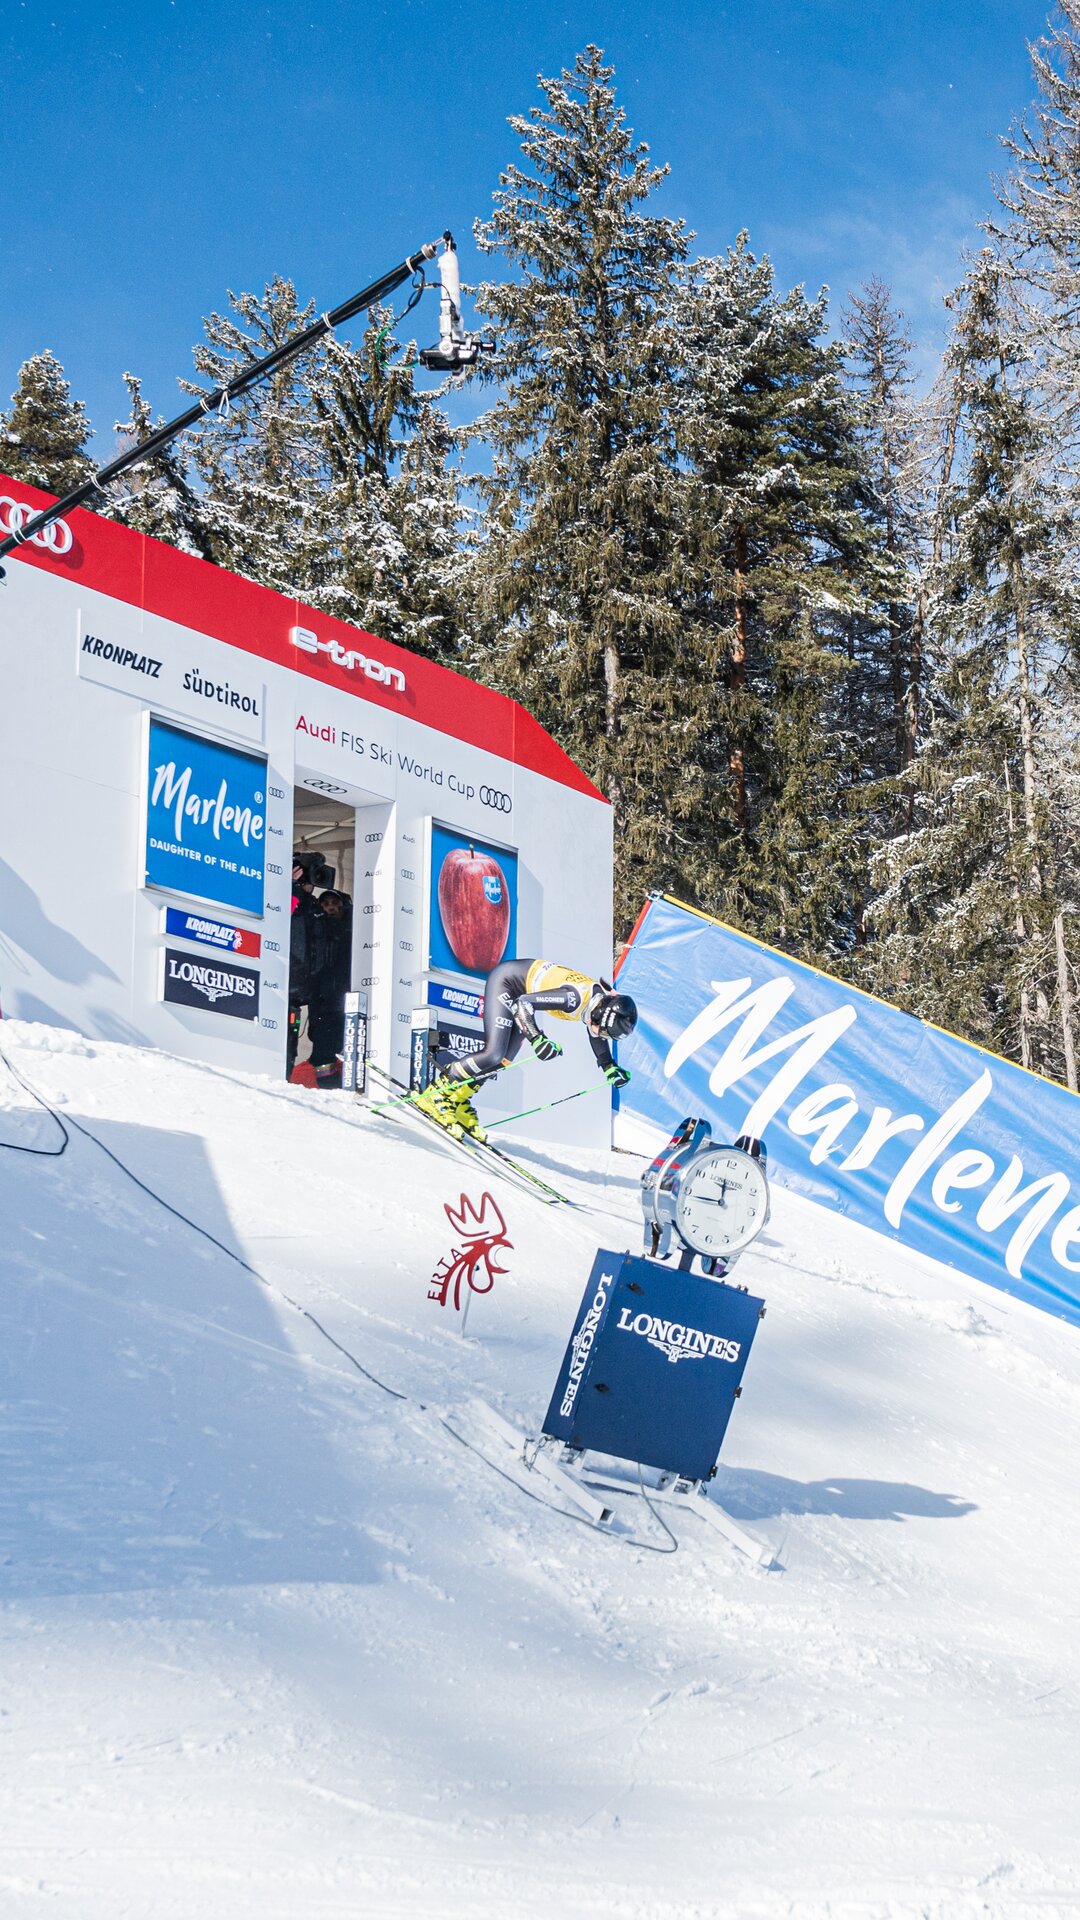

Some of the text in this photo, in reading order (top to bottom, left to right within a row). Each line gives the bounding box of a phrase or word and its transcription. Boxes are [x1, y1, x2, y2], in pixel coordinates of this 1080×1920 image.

[82, 634, 163, 679] KRONPLATZ
[290, 626, 405, 691] e-tron
[296, 715, 475, 800] Audi FIS Ski World Cup
[151, 761, 263, 848] Marlene
[268, 825, 283, 836] Audi
[149, 837, 263, 880] DAUGHTER OF THE ALPS
[266, 902, 282, 913] Audi
[185, 916, 236, 942] KRONPLATZ
[168, 959, 256, 997] LONGINES
[399, 977, 413, 988] Audi
[263, 979, 279, 990] Audi
[442, 988, 480, 1009] KRONPLATZ
[344, 1018, 355, 1088] LONGINES
[413, 1035, 423, 1092] LONGIN
[710, 1159, 719, 1169] 11
[726, 1159, 738, 1170] 12
[695, 1168, 707, 1179] 10
[744, 1171, 750, 1180] 1
[684, 1186, 693, 1196] 9
[748, 1187, 758, 1197] 2
[682, 1206, 692, 1217] 8
[747, 1207, 757, 1217] 3
[691, 1224, 700, 1234] 7
[736, 1225, 746, 1234] 4
[704, 1234, 713, 1244] 6
[721, 1234, 731, 1244] 5
[427, 1247, 463, 1302] ERTA
[616, 1307, 742, 1363] LONGINES
[559, 1272, 613, 1418] LONGINES
